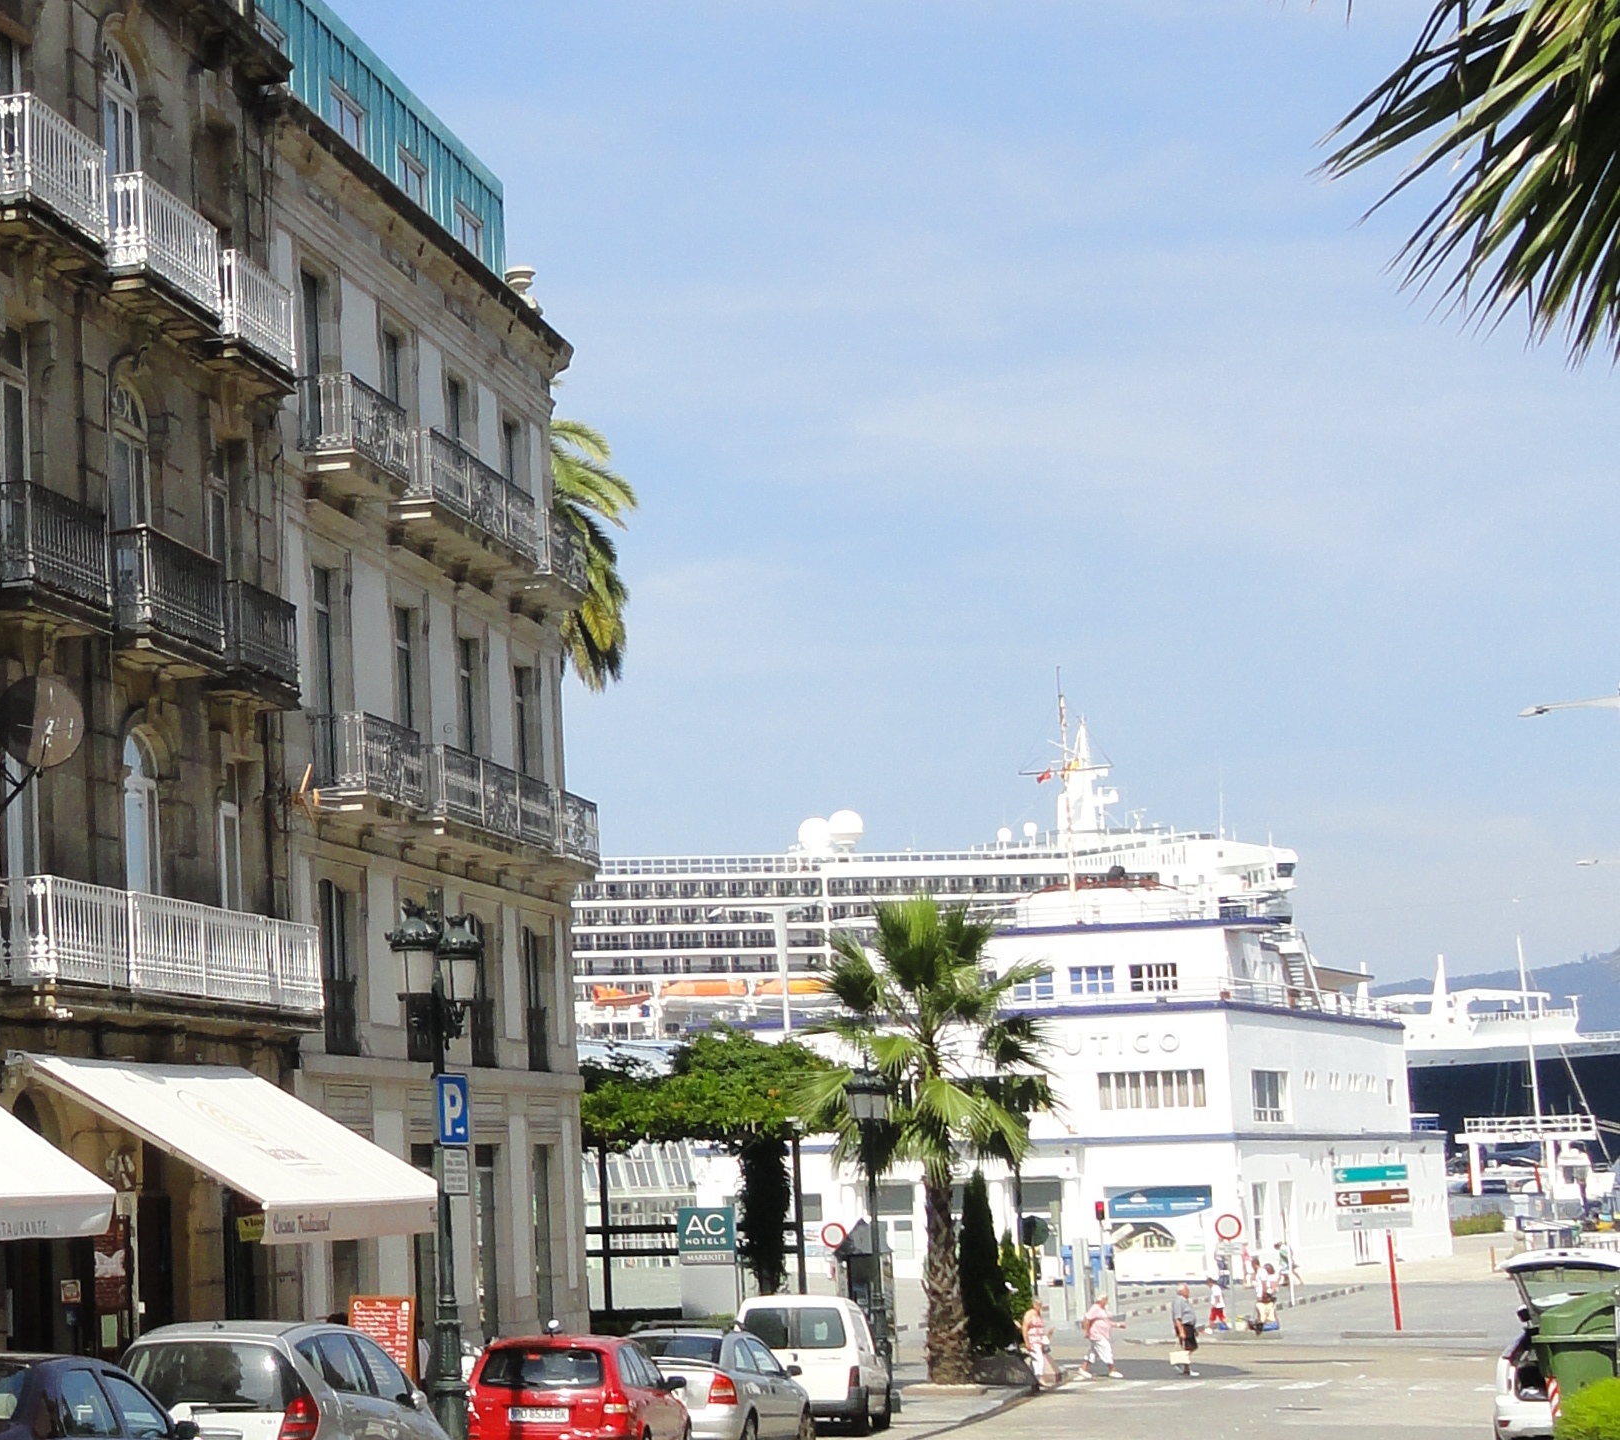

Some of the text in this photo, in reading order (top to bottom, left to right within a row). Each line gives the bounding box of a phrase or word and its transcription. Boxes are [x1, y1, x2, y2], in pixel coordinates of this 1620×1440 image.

[1035, 1031, 1181, 1057] AUTICO
[443, 1083, 463, 1136] P
[685, 1213, 726, 1236] AC
[685, 1237, 727, 1245] HOTELS
